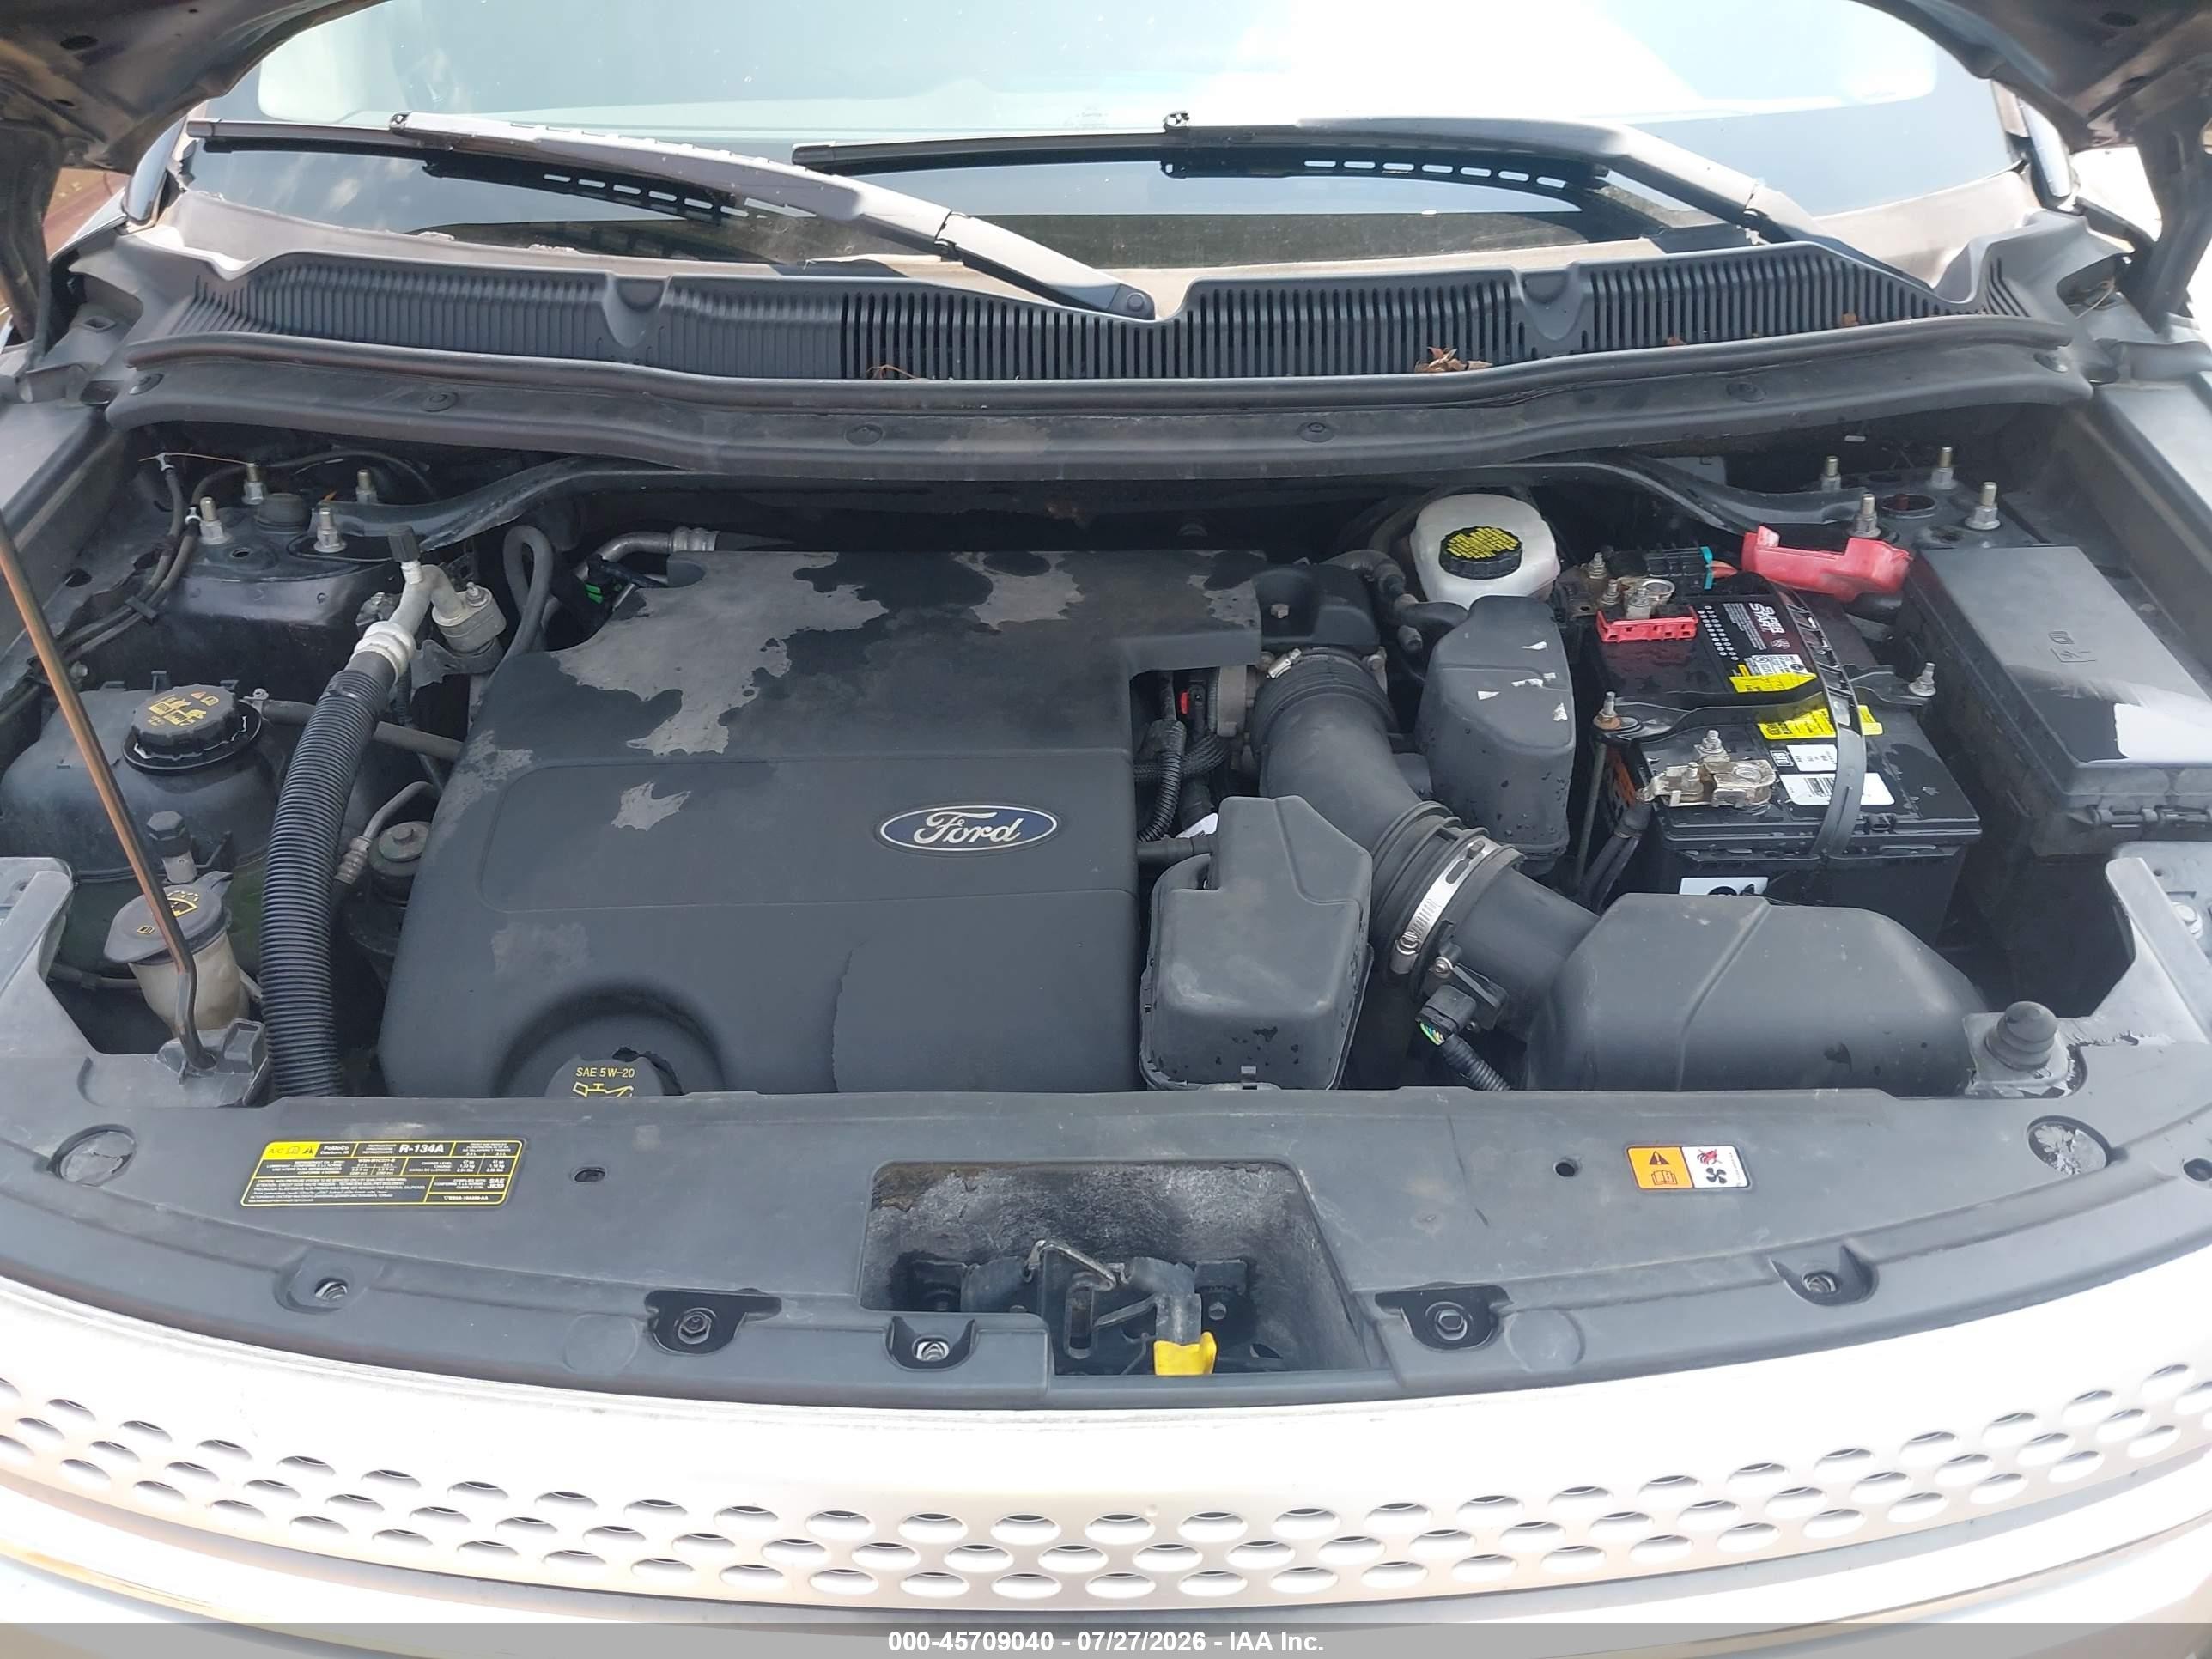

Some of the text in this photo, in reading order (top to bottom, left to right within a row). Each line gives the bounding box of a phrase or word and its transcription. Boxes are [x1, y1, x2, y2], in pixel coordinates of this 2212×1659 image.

[1748, 603, 1771, 633] START
[1763, 606, 1785, 634] SUPER
[913, 811, 1024, 844] Ford
[575, 1067, 635, 1078] SAE 5W-20
[398, 1144, 445, 1154] R-134A
